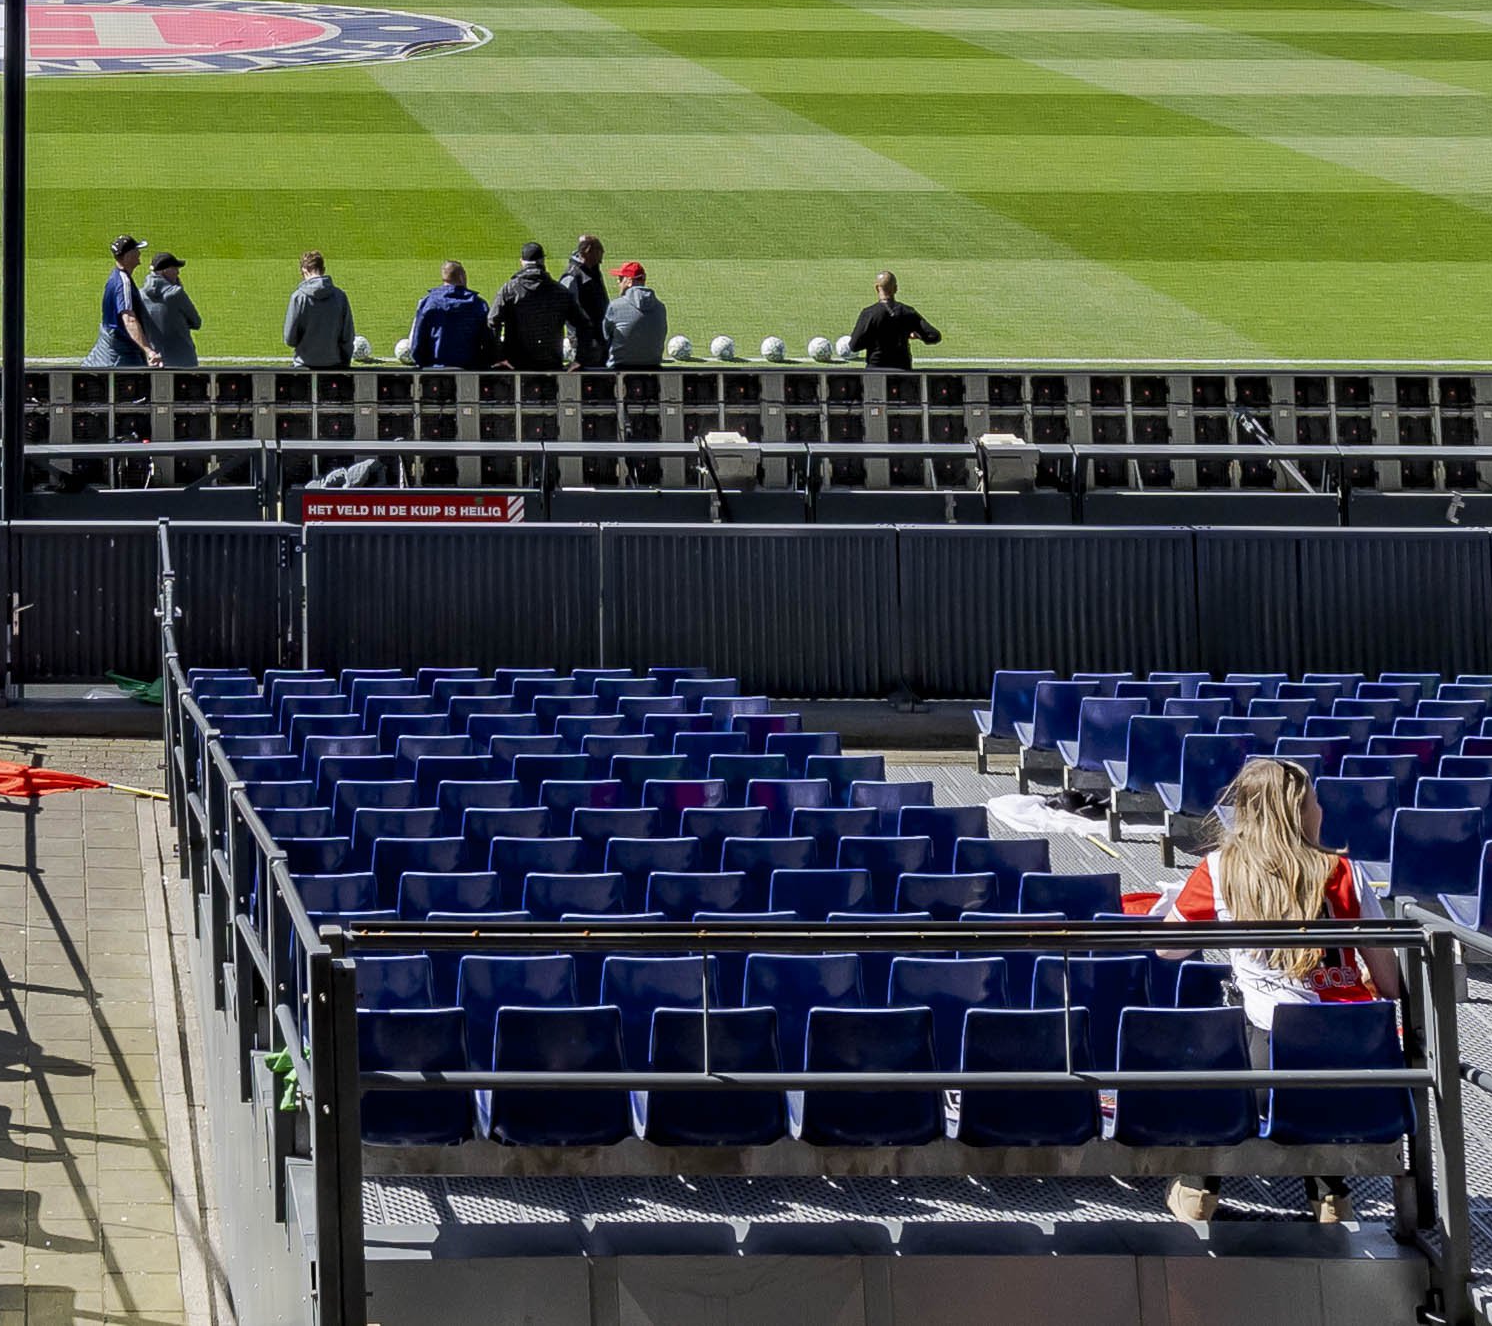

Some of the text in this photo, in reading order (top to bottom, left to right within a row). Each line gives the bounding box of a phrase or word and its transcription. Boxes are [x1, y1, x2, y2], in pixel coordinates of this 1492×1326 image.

[307, 505, 502, 517] HET VELD IN DE KUIP IS HEILIG
